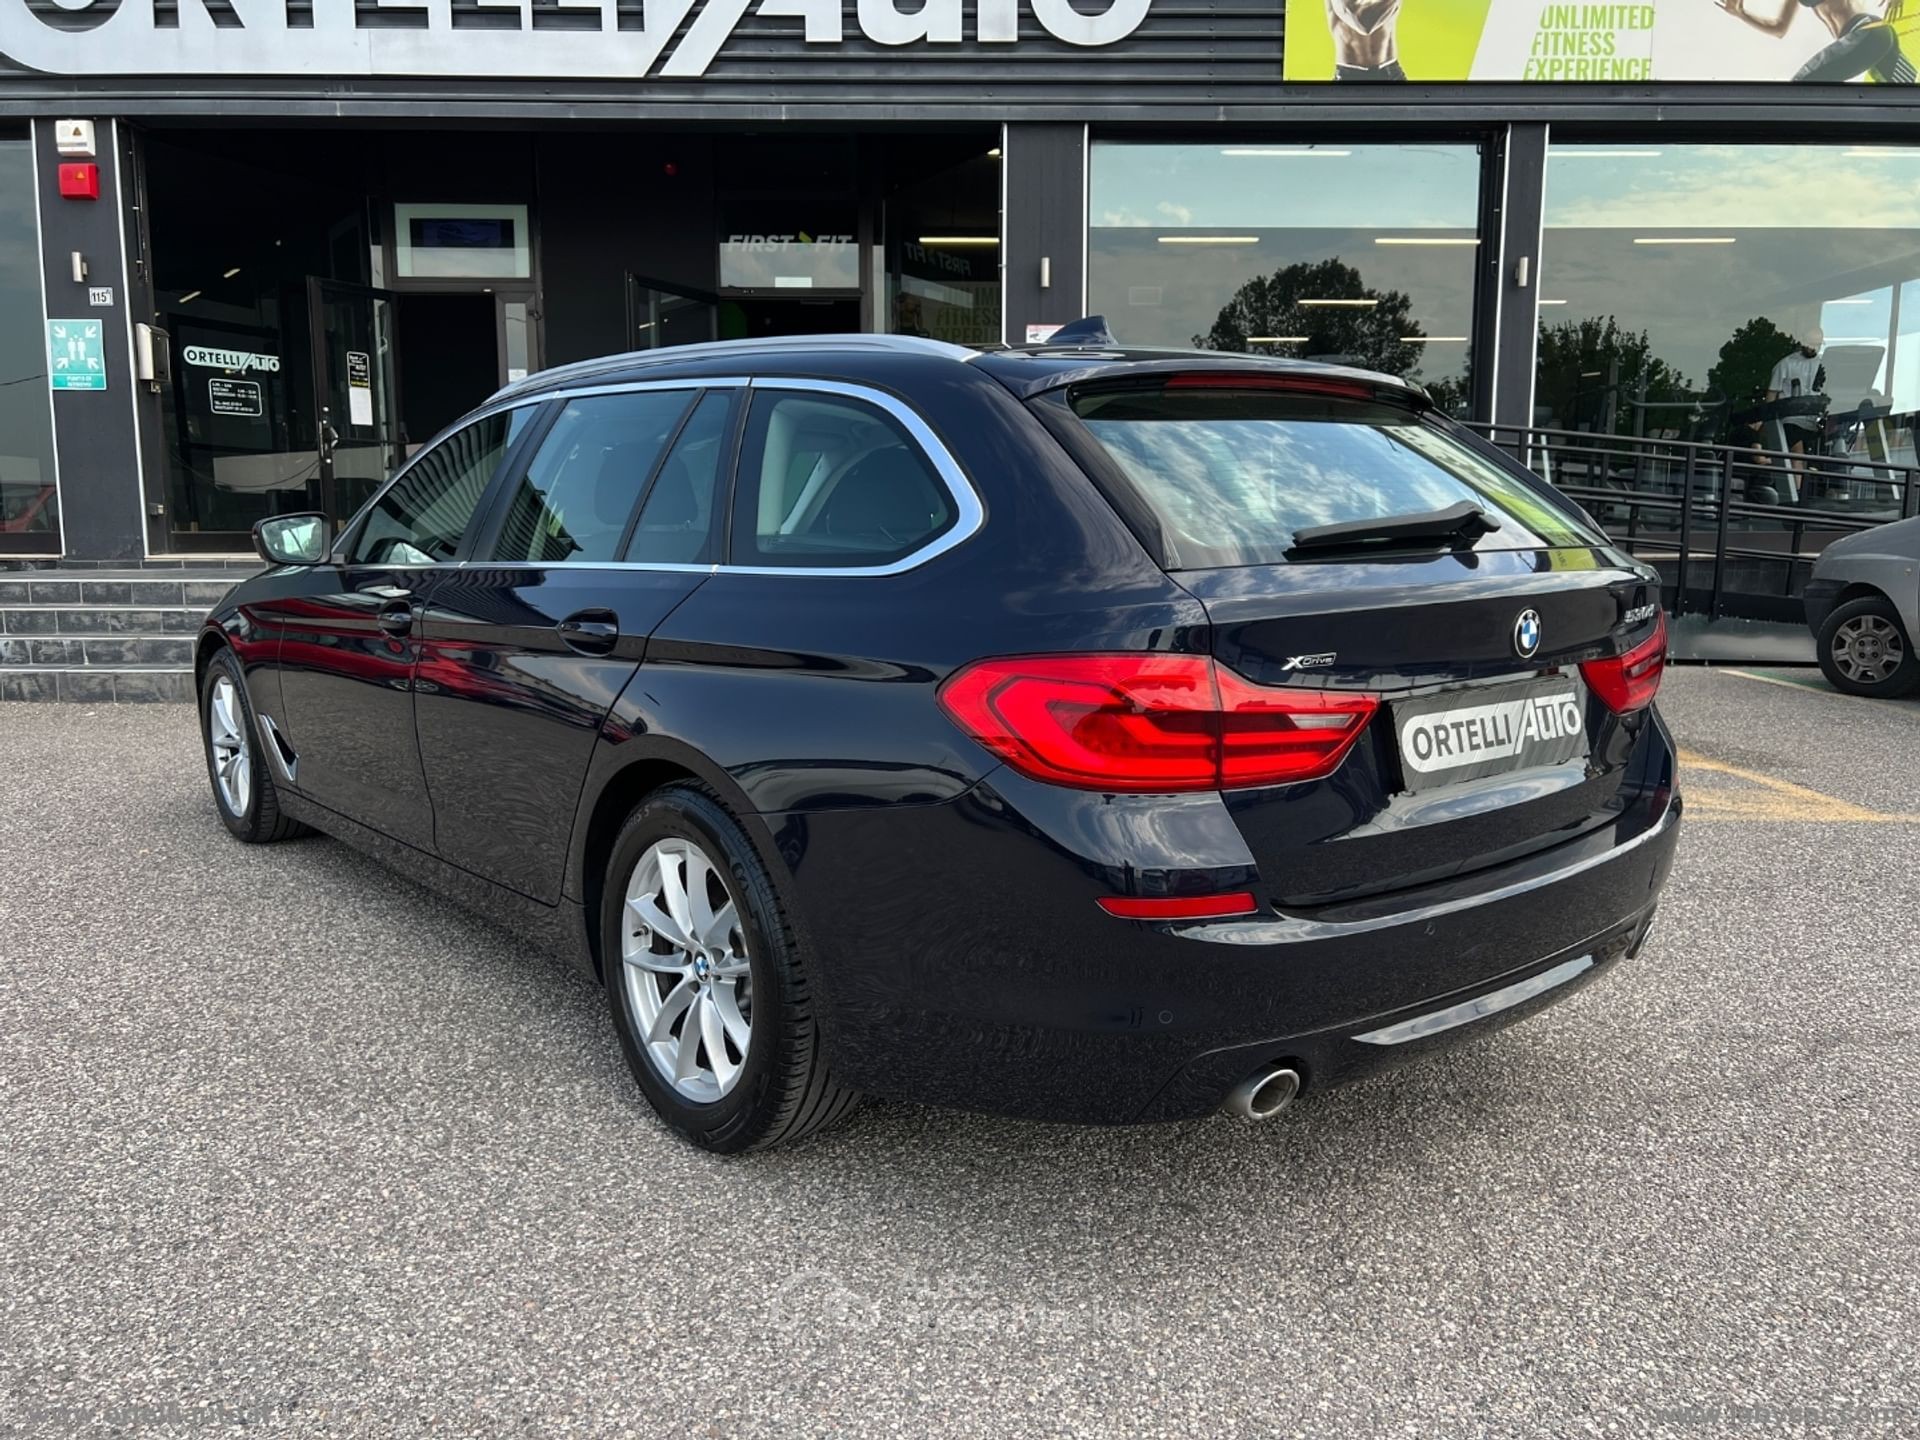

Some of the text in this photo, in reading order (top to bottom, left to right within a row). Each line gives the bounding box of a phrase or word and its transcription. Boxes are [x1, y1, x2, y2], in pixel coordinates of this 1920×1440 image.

[1540, 5, 1655, 30] UNLIMITED
[1531, 31, 1615, 56] FITNESS
[1523, 58, 1652, 81] EXPERIENCE
[727, 234, 853, 252] FIRST FIT
[186, 350, 240, 367] ORTELLI
[1412, 713, 1513, 762] ORTELLI
